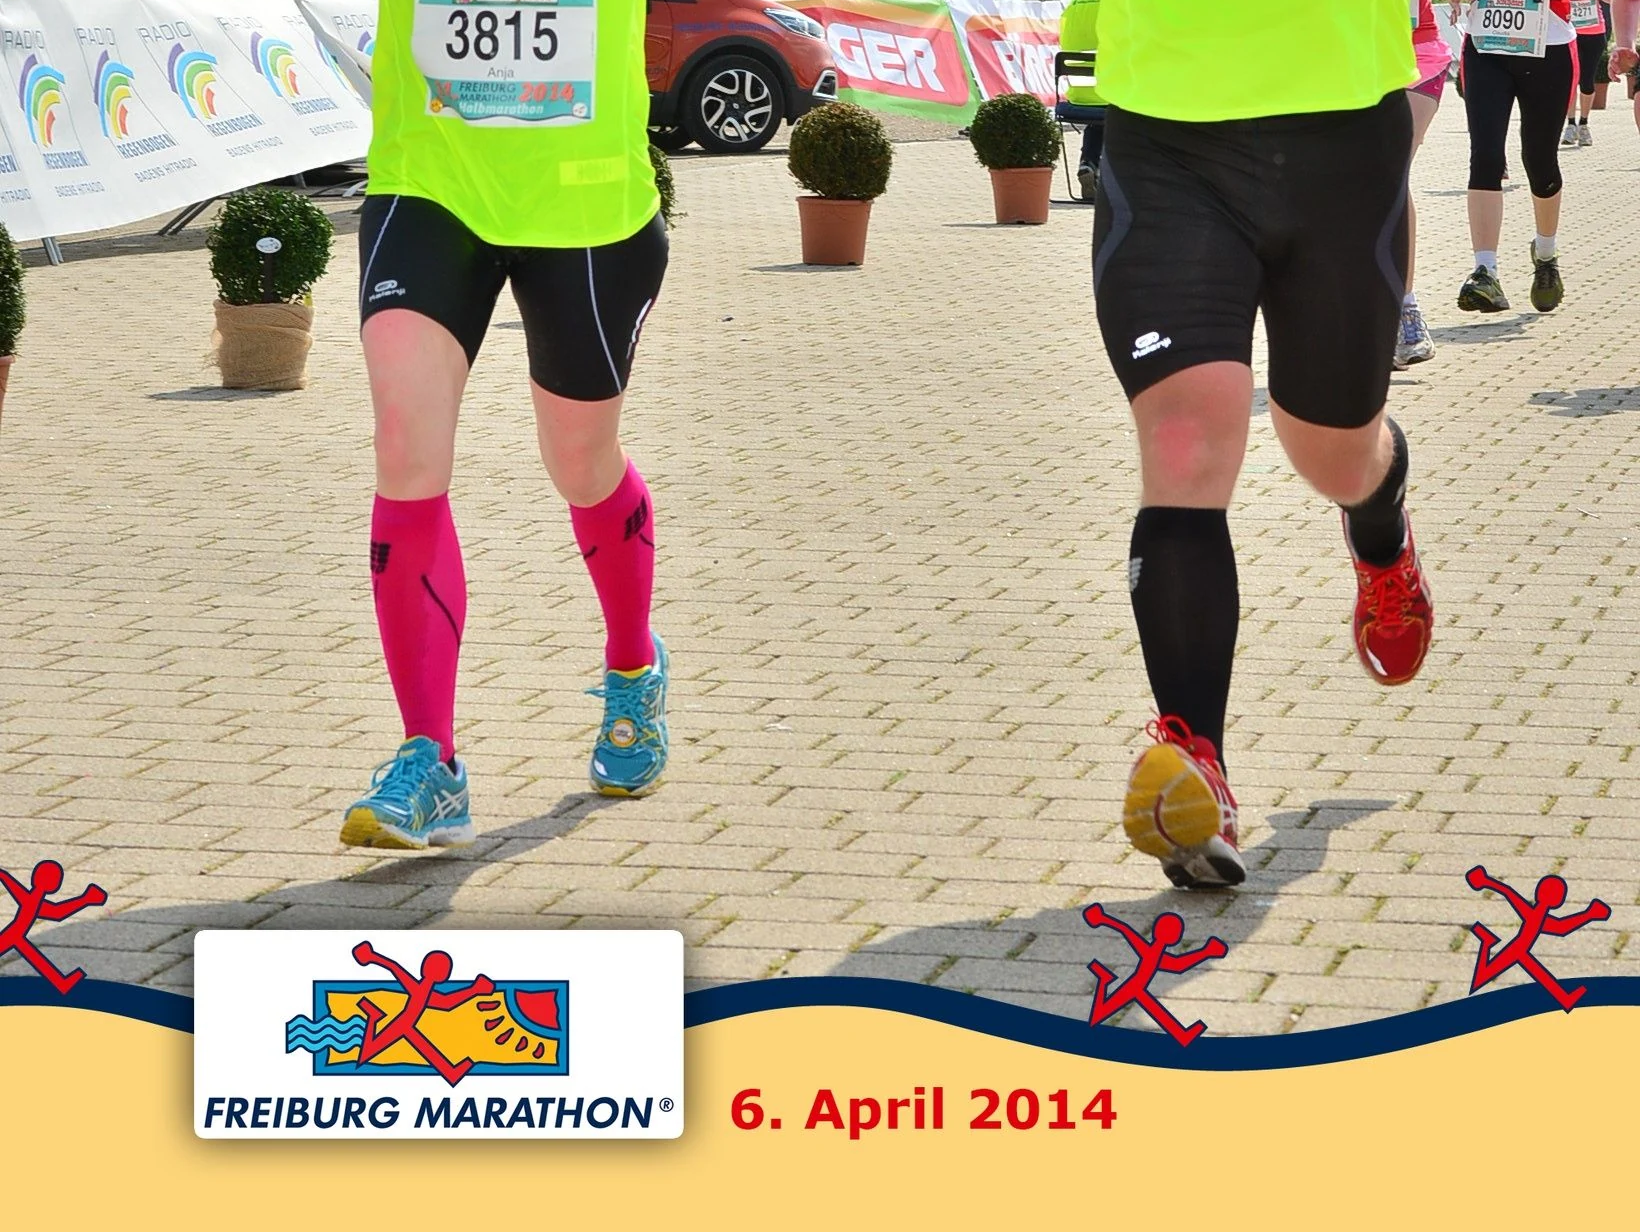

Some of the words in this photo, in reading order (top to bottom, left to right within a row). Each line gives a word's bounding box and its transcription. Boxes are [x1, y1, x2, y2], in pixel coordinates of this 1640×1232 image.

[333, 14, 374, 30] RADIO
[1482, 9, 1525, 31] 8090
[4, 30, 45, 50] RADIO
[76, 27, 116, 46] RADIO
[138, 21, 192, 43] RADIO
[446, 10, 558, 61] 3815
[488, 68, 515, 79] Anja
[459, 82, 516, 93] FREIBURG
[519, 82, 574, 103] 2014
[459, 94, 516, 103] MARATHON
[459, 102, 544, 114] Halbmarathon
[206, 114, 263, 138] REGENBOGEN
[115, 133, 177, 159] REGENBOGEN
